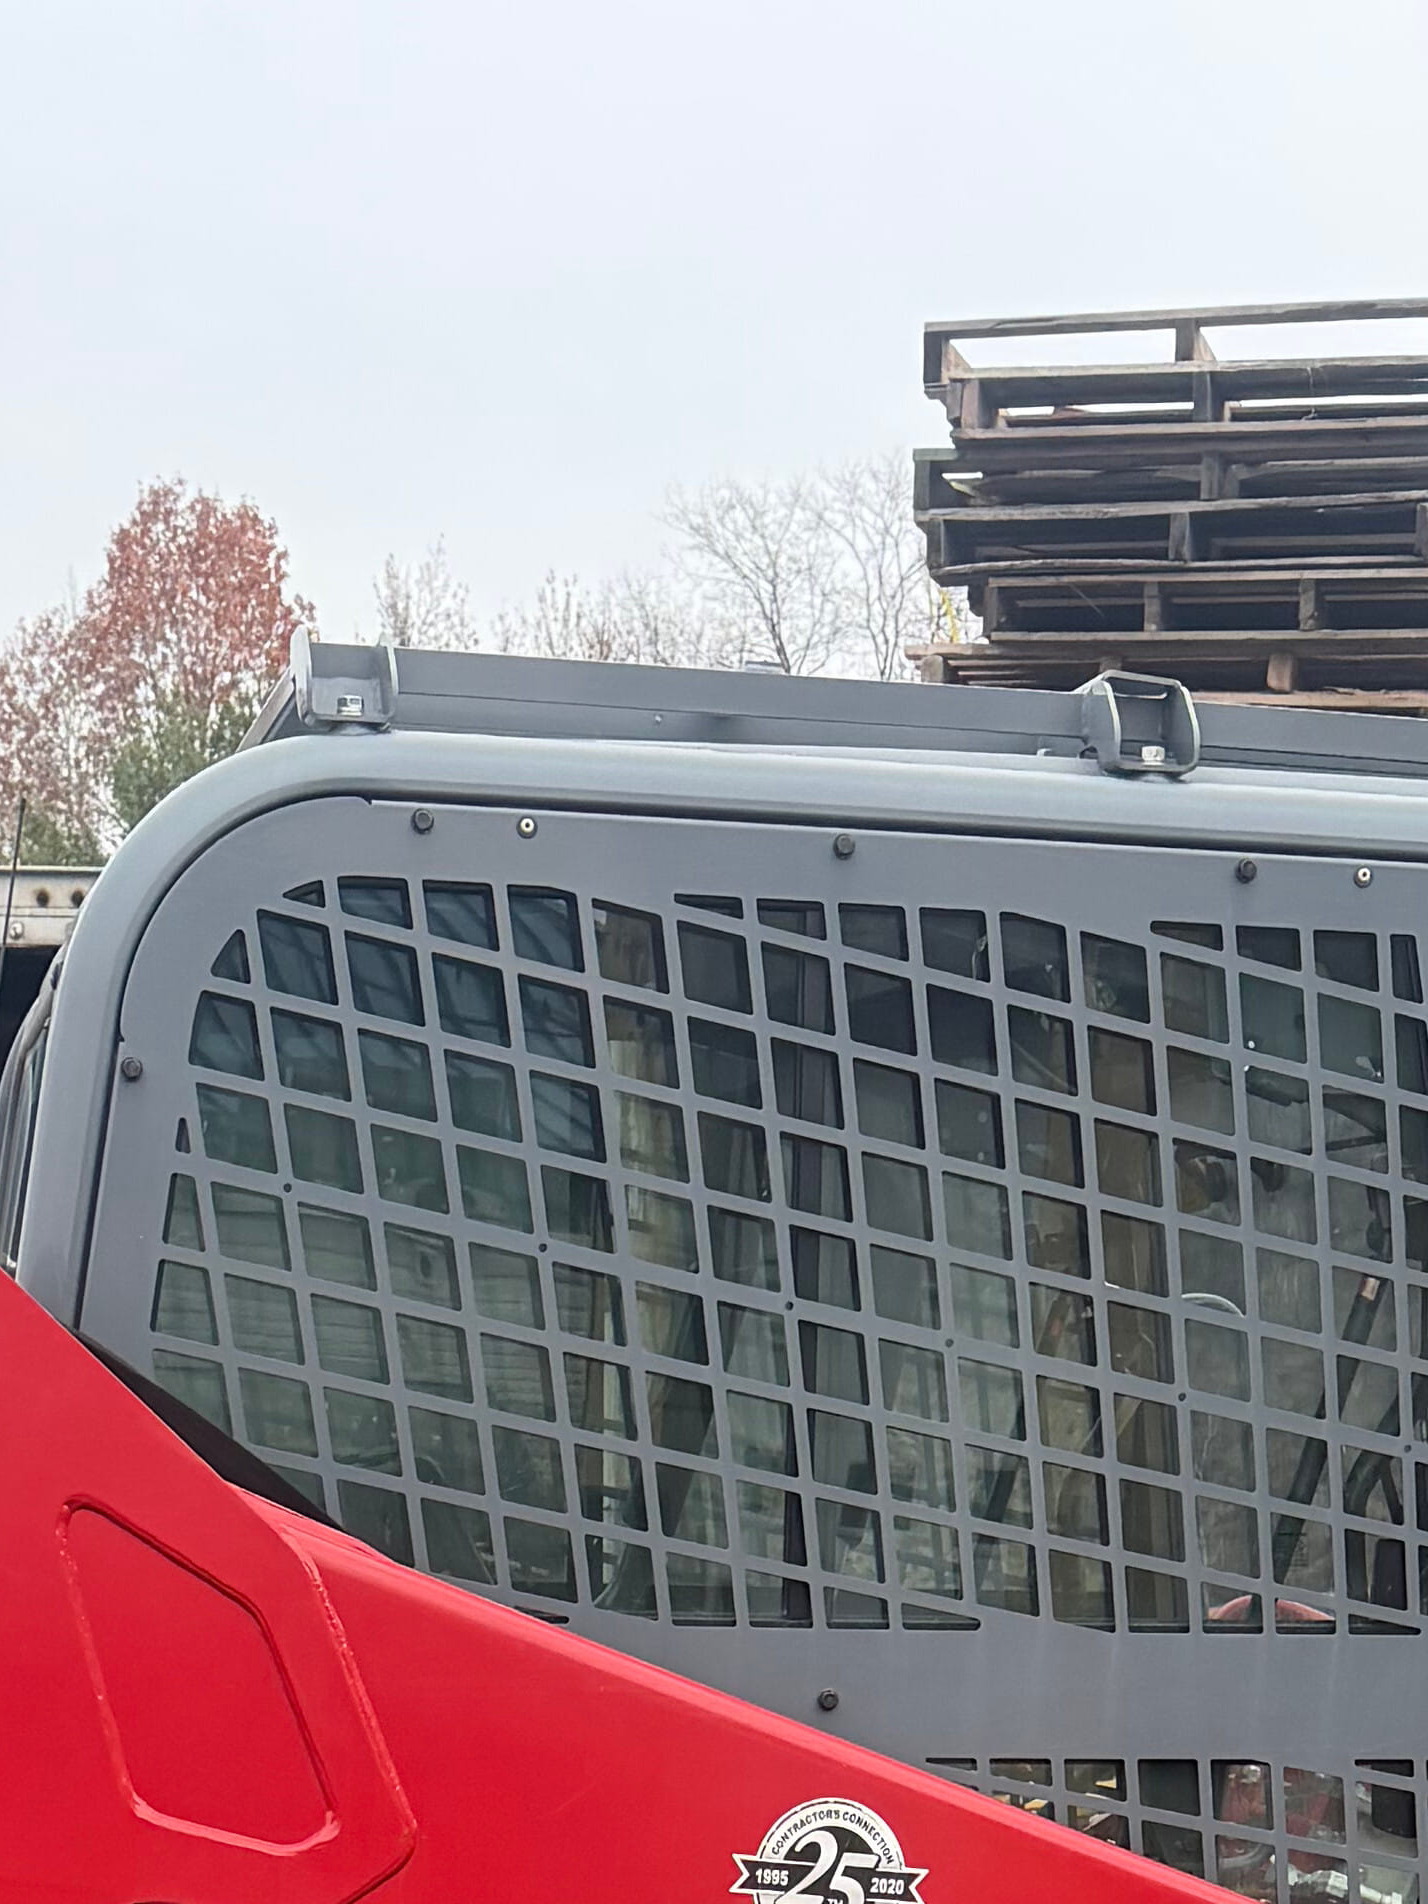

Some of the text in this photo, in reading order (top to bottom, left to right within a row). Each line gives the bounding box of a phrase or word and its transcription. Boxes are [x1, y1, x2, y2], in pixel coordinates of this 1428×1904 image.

[842, 1811, 895, 1865] CONNECTION
[755, 1868, 789, 1887] 1995
[869, 1877, 905, 1896] 2020
